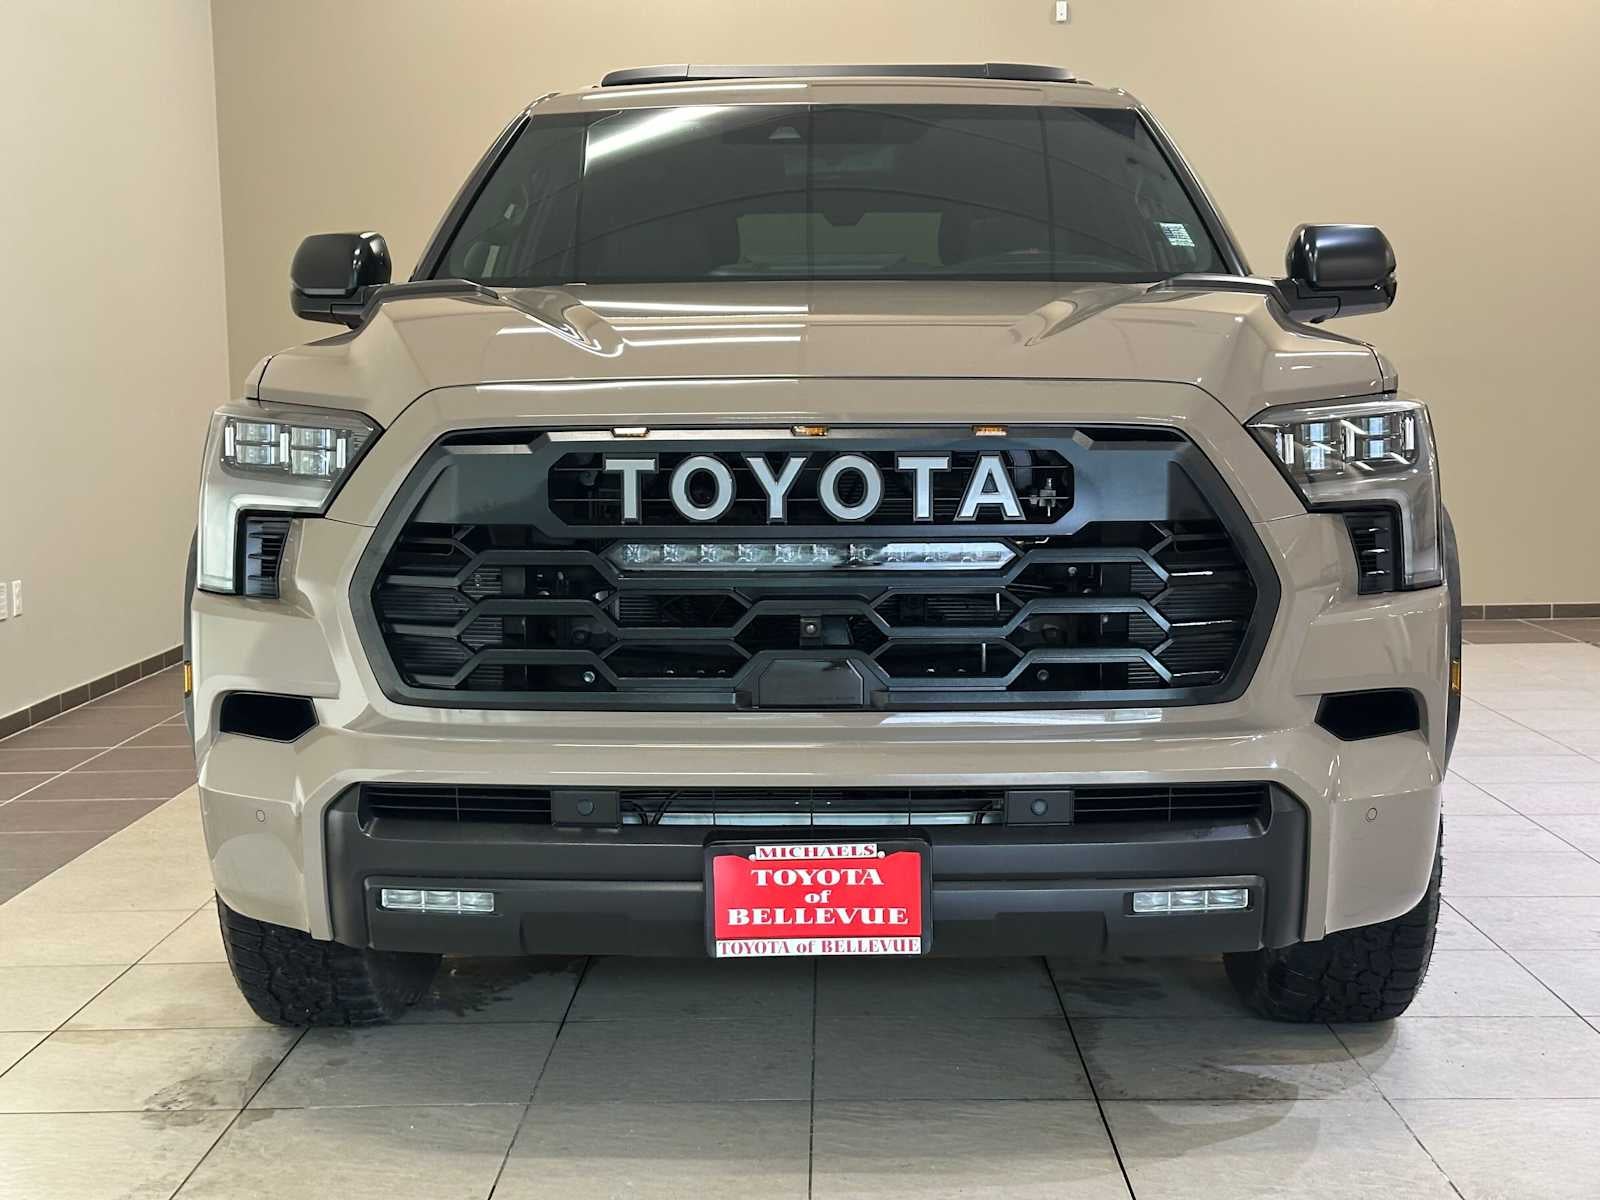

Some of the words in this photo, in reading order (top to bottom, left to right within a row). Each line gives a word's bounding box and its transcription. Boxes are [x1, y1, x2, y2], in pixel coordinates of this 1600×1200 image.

[604, 456, 1025, 523] TOYOTA
[758, 845, 876, 859] MICHAELS
[752, 868, 884, 887] TOYOTA
[804, 890, 832, 904] of
[728, 907, 909, 926] BELLEVUE
[719, 941, 790, 955] TOYOTA
[796, 941, 814, 953] of
[821, 938, 919, 954] BELLEVUE
